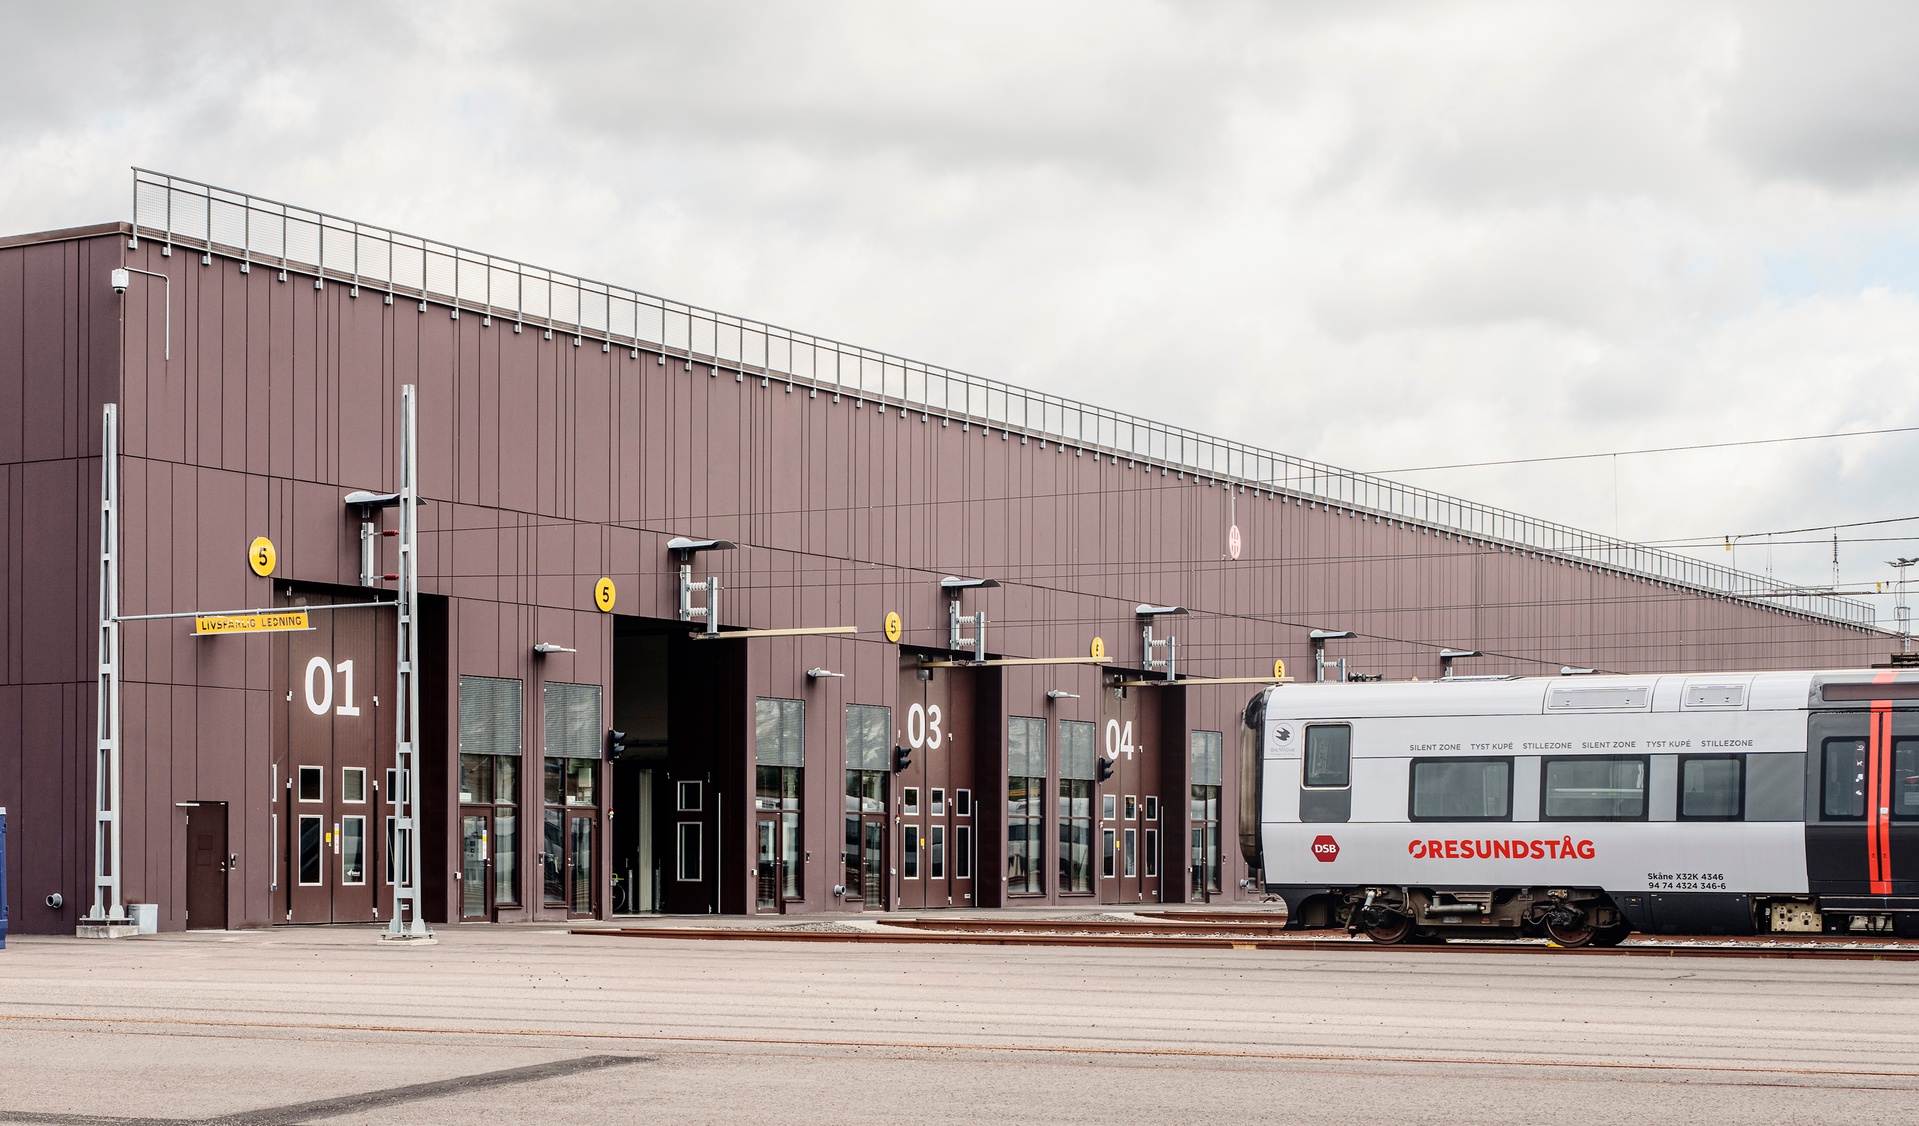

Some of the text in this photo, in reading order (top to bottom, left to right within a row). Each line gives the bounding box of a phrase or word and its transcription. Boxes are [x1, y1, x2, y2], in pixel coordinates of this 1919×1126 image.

[258, 547, 268, 566] 5
[602, 586, 610, 603] 5
[261, 616, 302, 627] LEDNING
[890, 619, 897, 634] 5
[305, 656, 360, 717] 01
[907, 702, 943, 750] 03
[1105, 718, 1135, 761] 04
[1668, 739, 1691, 748] KUPÉ
[1701, 739, 1753, 747] STILLEZONE
[1438, 743, 1461, 751] ZONE
[1492, 741, 1514, 750] KUPÉ
[1522, 742, 1573, 750] STILLEZONE
[1314, 844, 1337, 854] DSB
[1408, 835, 1596, 860] ØRESUNDSTÅG
[1647, 872, 1673, 880] Skåne
